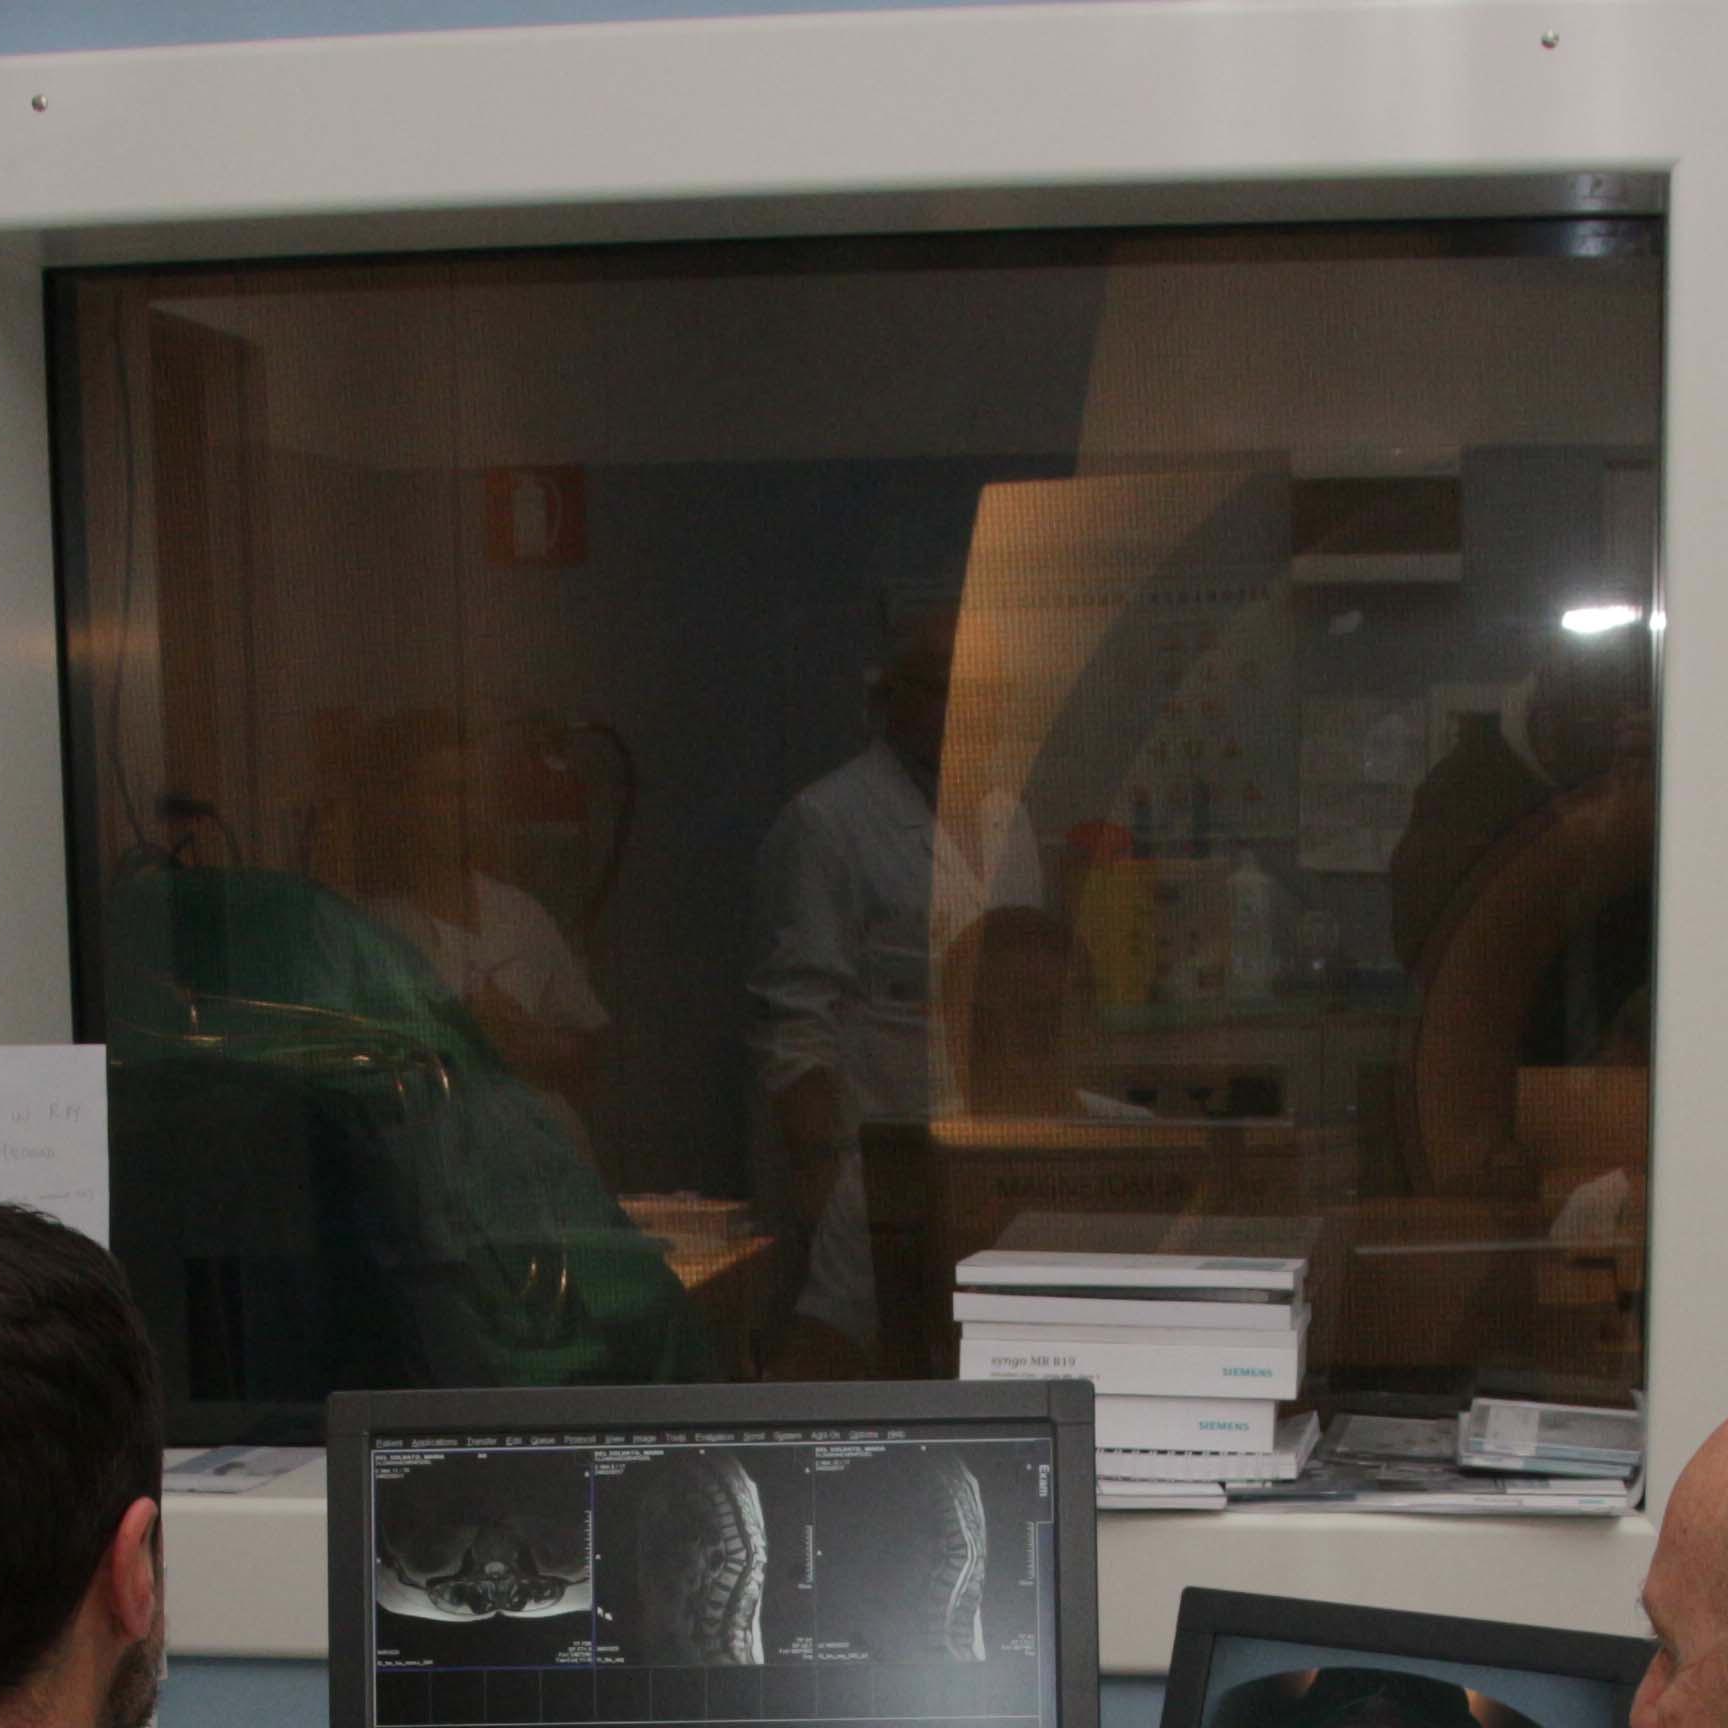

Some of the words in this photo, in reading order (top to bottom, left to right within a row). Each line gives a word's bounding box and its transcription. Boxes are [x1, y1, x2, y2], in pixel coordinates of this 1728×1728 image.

[1222, 1366, 1273, 1378] SIEMENS
[1199, 1420, 1250, 1432] SIEMENS
[1037, 1463, 1050, 1498] Exam
